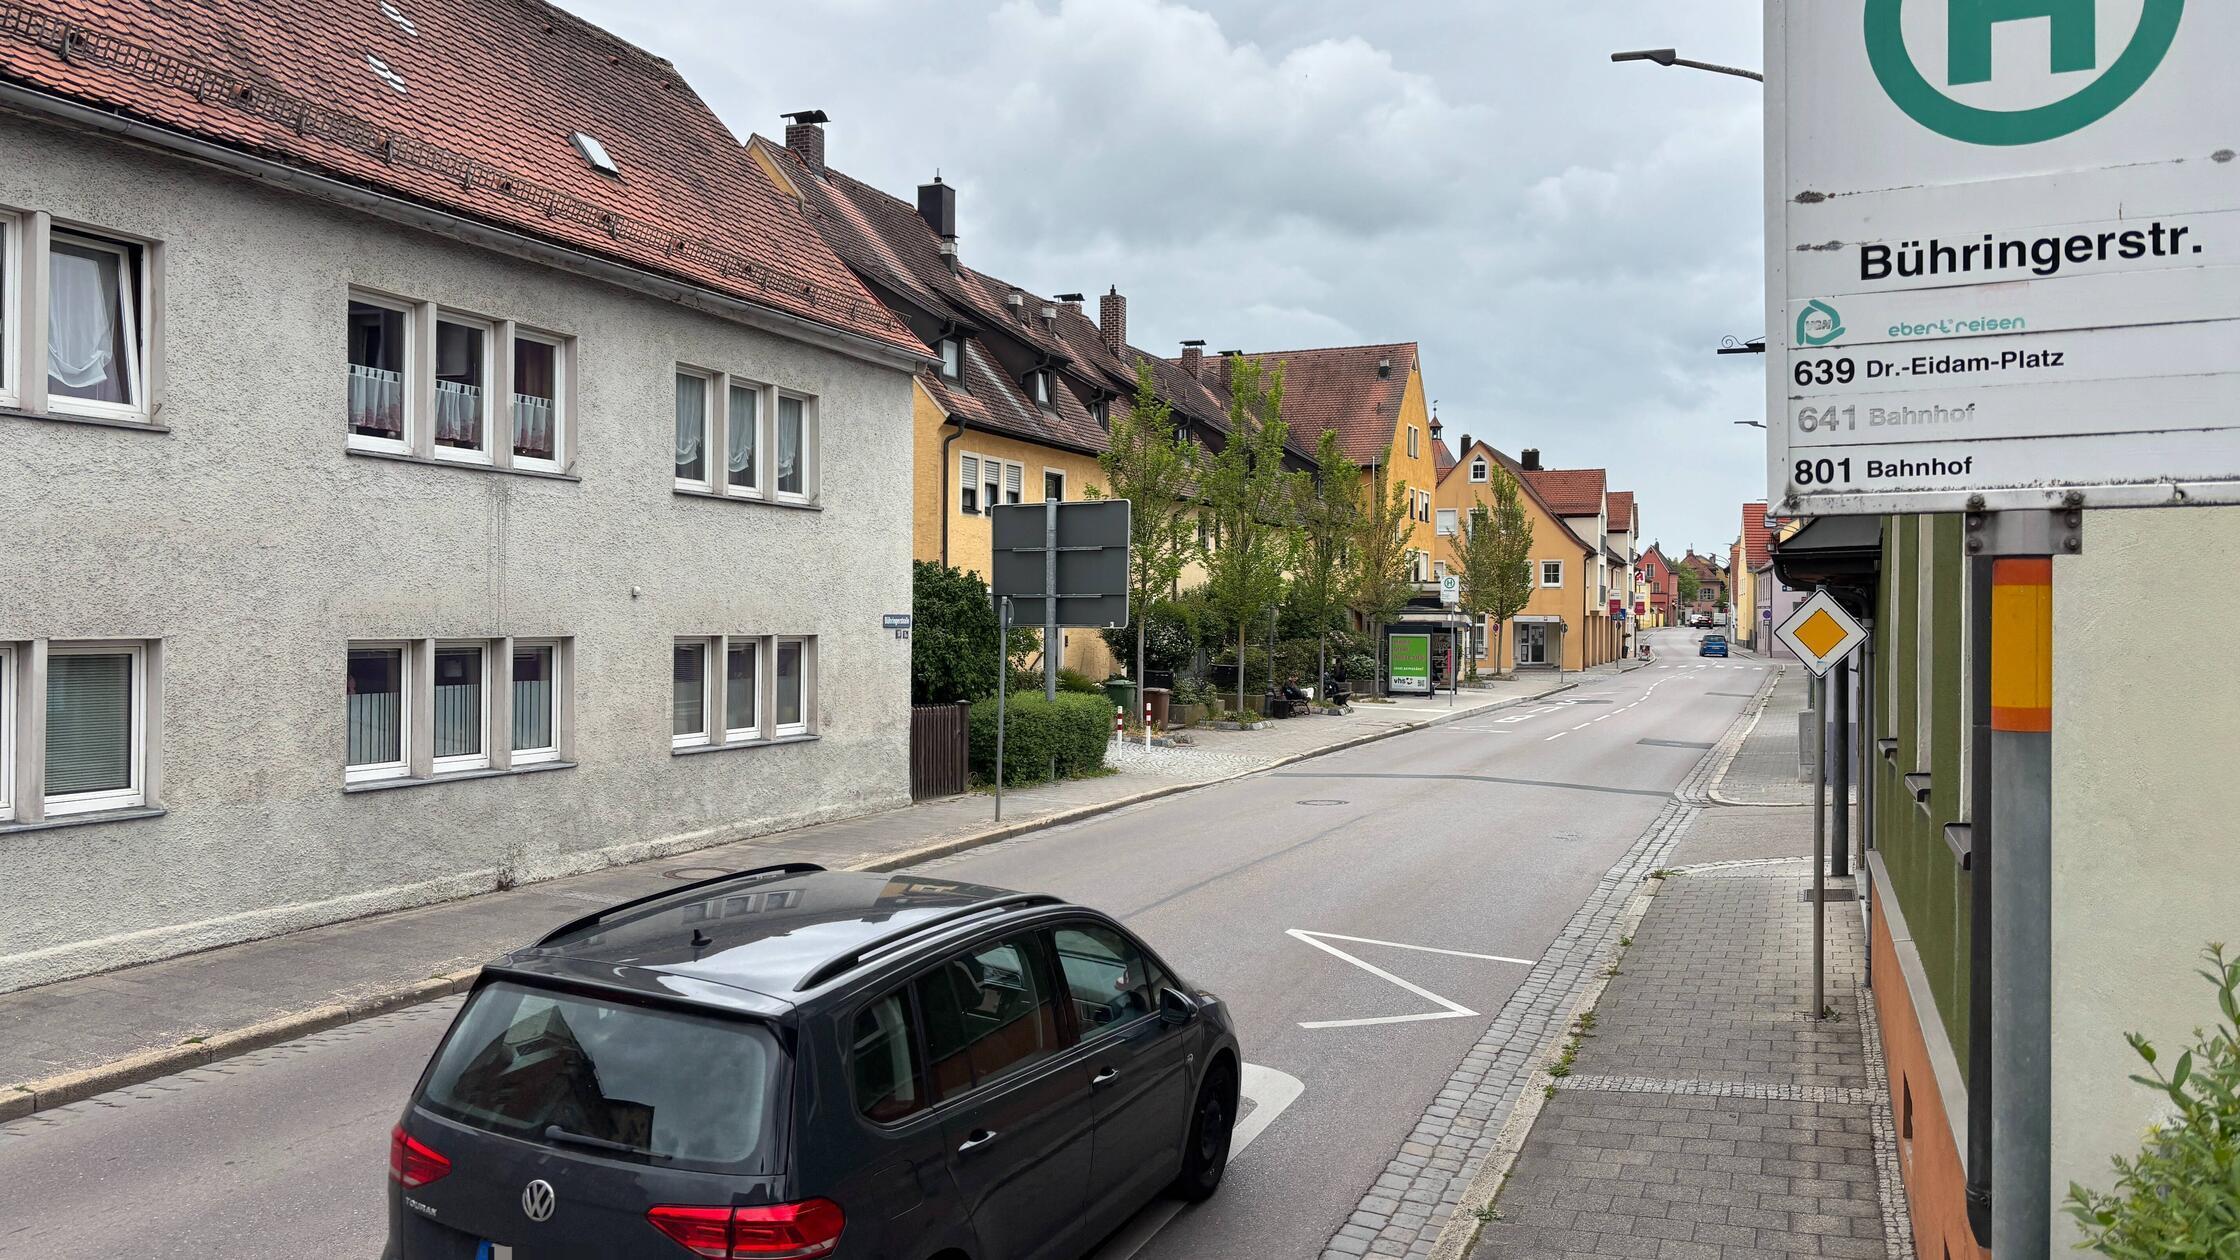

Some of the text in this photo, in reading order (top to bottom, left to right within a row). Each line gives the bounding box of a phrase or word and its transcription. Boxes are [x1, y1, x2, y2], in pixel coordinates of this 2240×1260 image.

[1861, 222, 2202, 280] Bühringerstr.
[1794, 350, 2064, 387] 639 Dr.-Eidam-Platz
[1798, 403, 1975, 433] 641 Bahnhof
[1794, 456, 1972, 485] 801 Bahnhof
